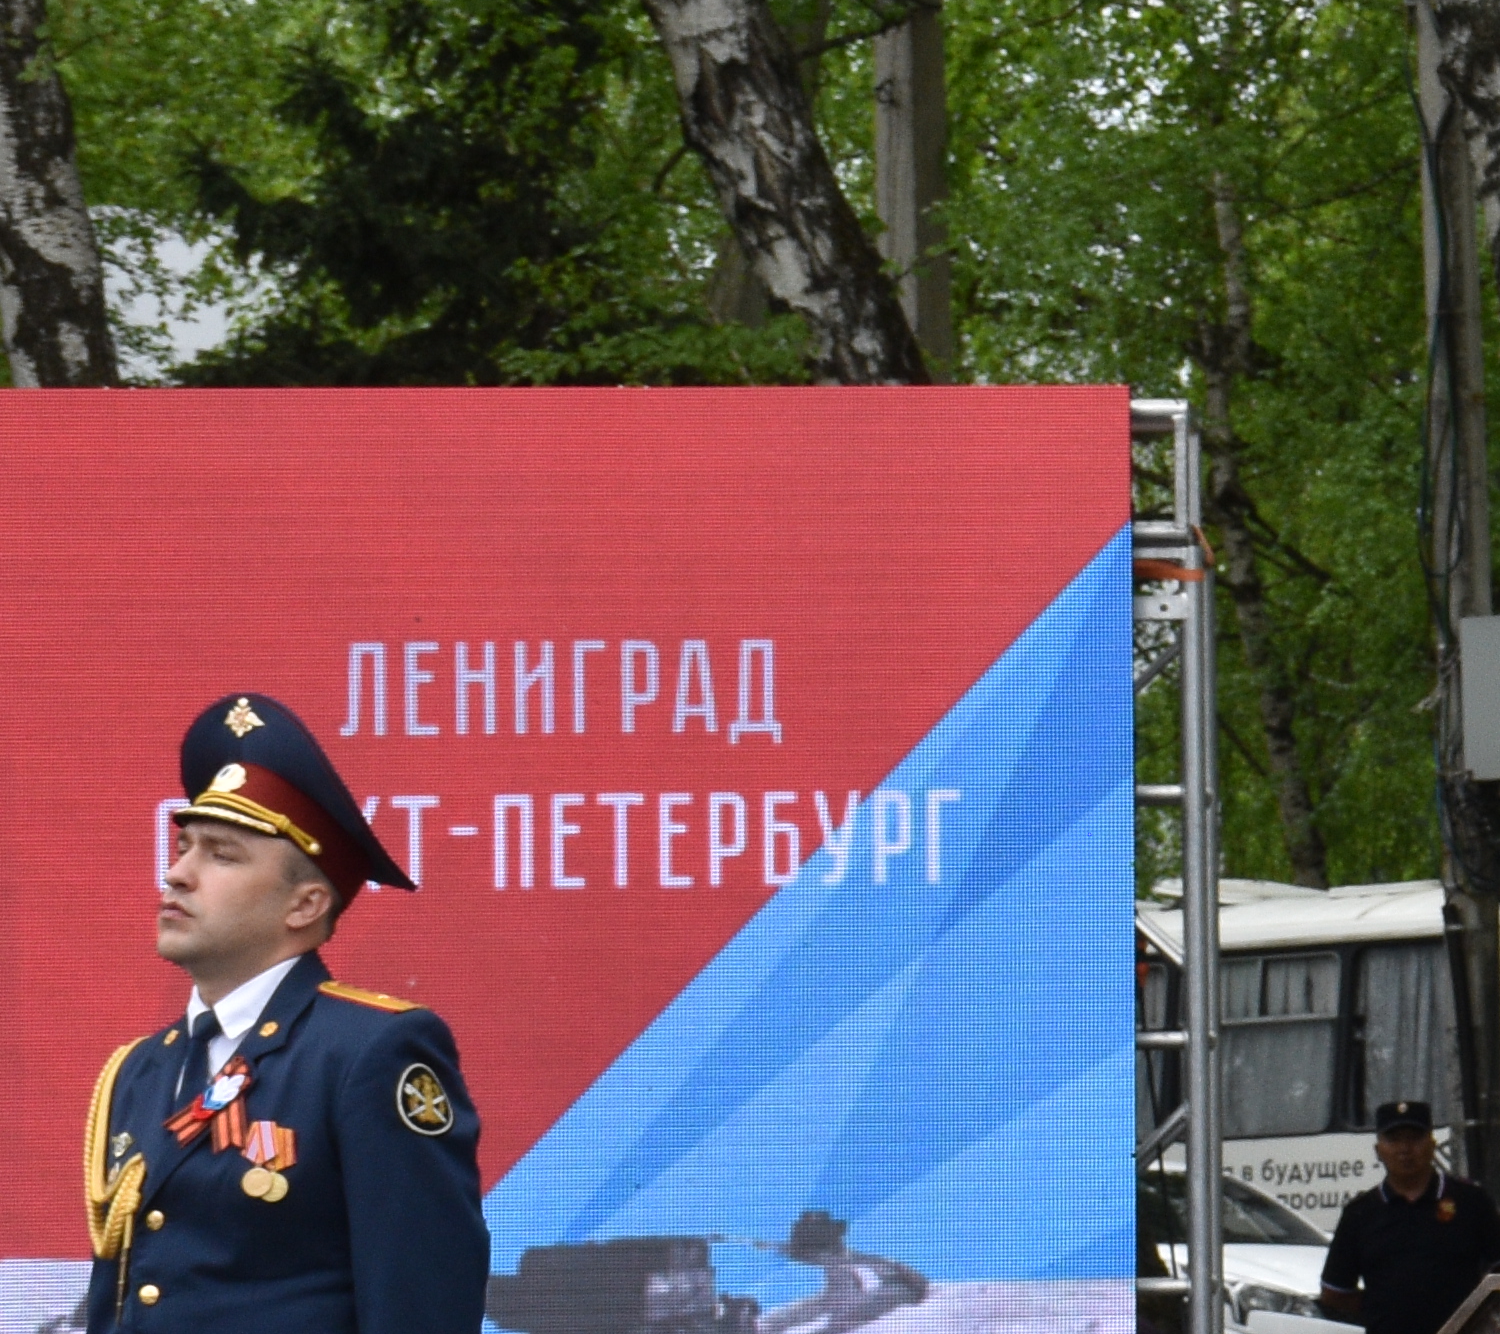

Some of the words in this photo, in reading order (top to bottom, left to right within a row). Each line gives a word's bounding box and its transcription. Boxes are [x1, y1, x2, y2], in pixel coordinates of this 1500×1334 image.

[340, 639, 782, 744] ЛЕНИГРАД
[157, 789, 961, 891] СТ-ПЕТЕРБУРГ
[1261, 1158, 1364, 1186] будущее
